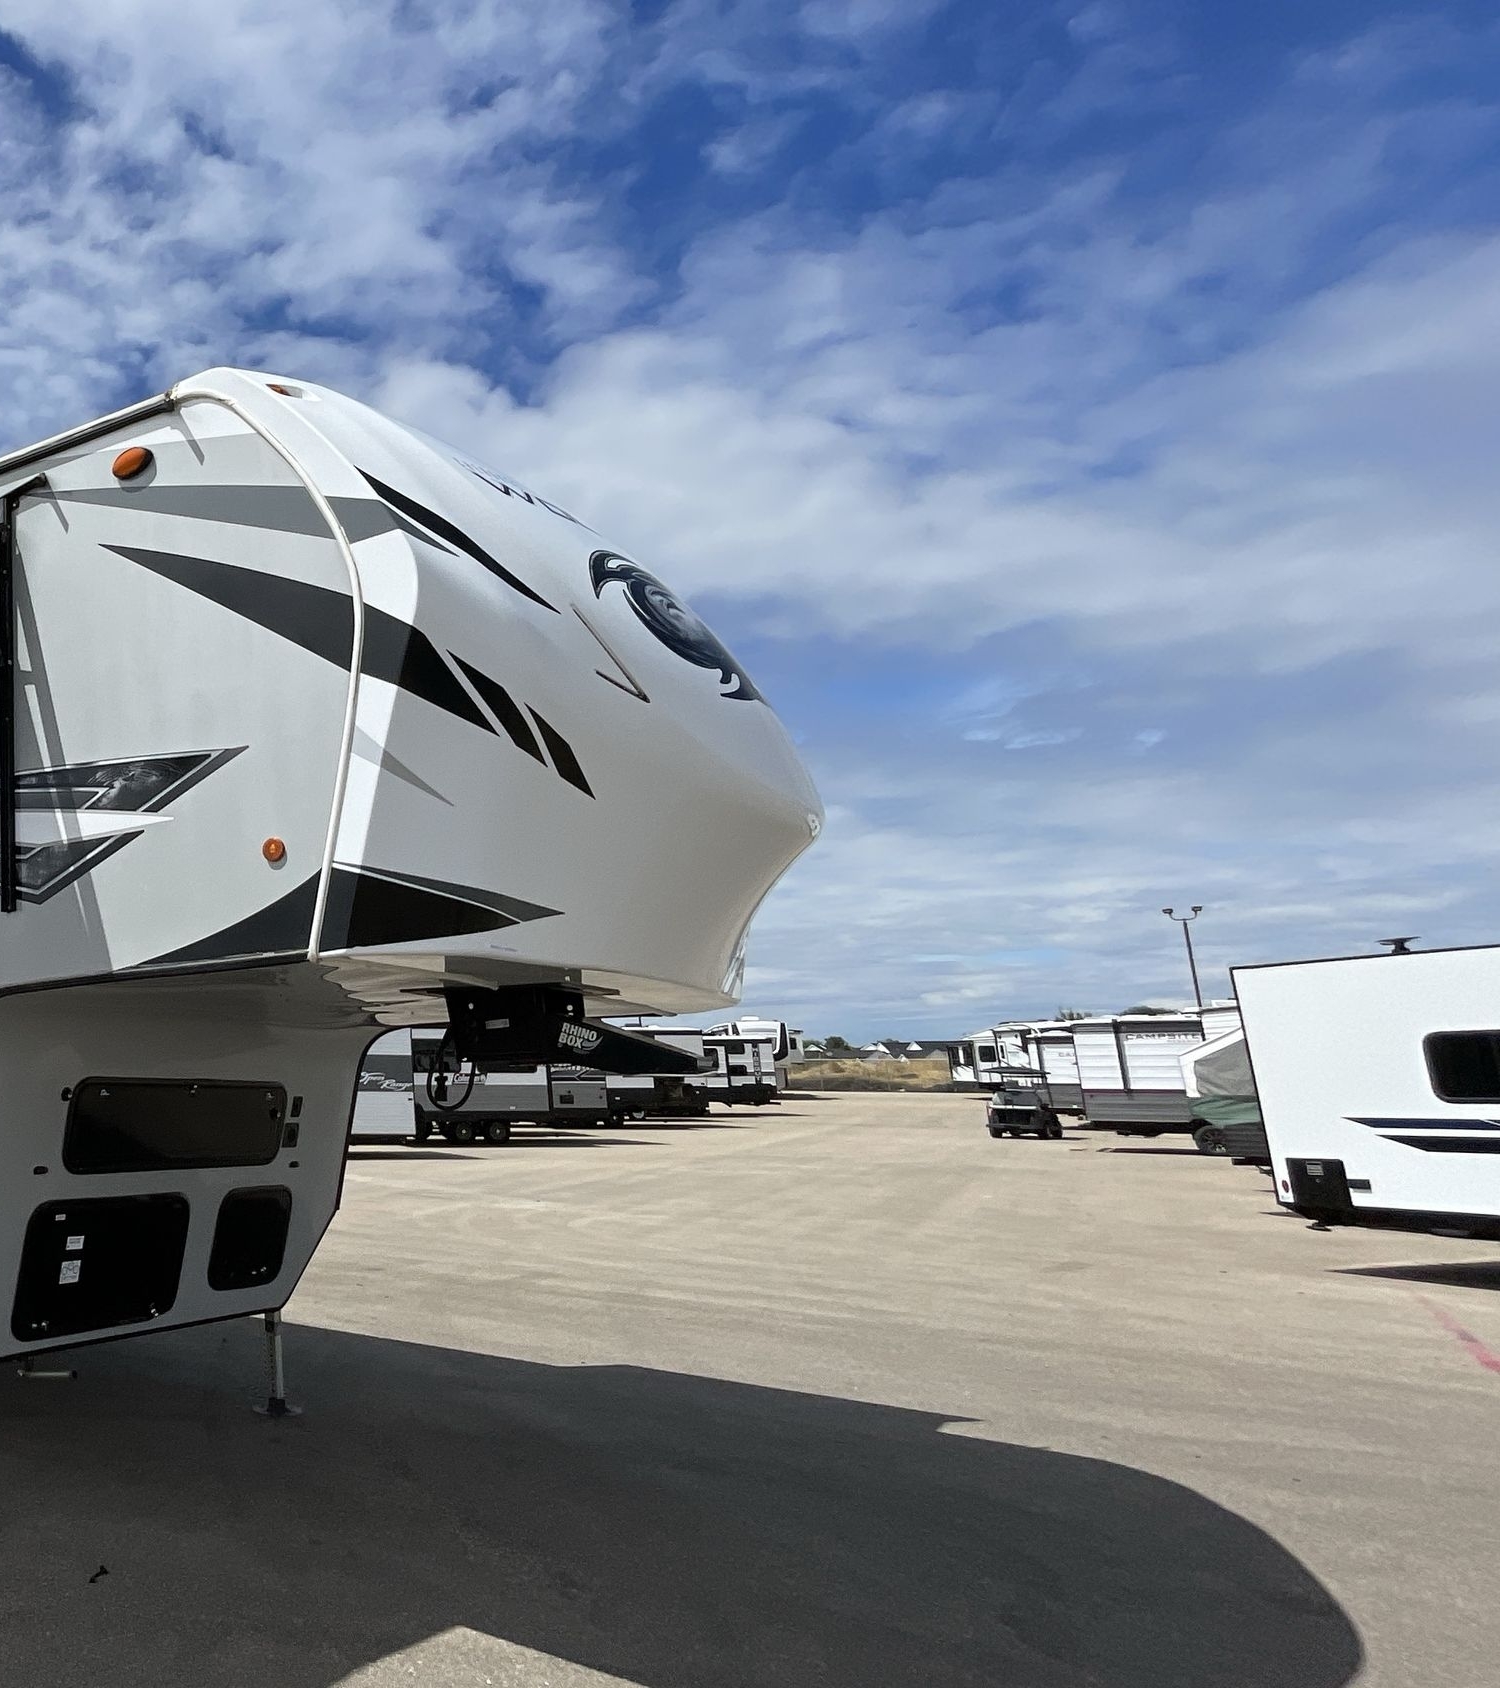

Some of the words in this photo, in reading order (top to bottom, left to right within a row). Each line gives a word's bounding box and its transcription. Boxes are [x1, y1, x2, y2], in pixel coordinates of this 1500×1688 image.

[561, 1022, 598, 1041] RHINO
[1125, 1033, 1201, 1041] CAMPSITE
[558, 1032, 584, 1049] BOX
[378, 1078, 413, 1092] Range
